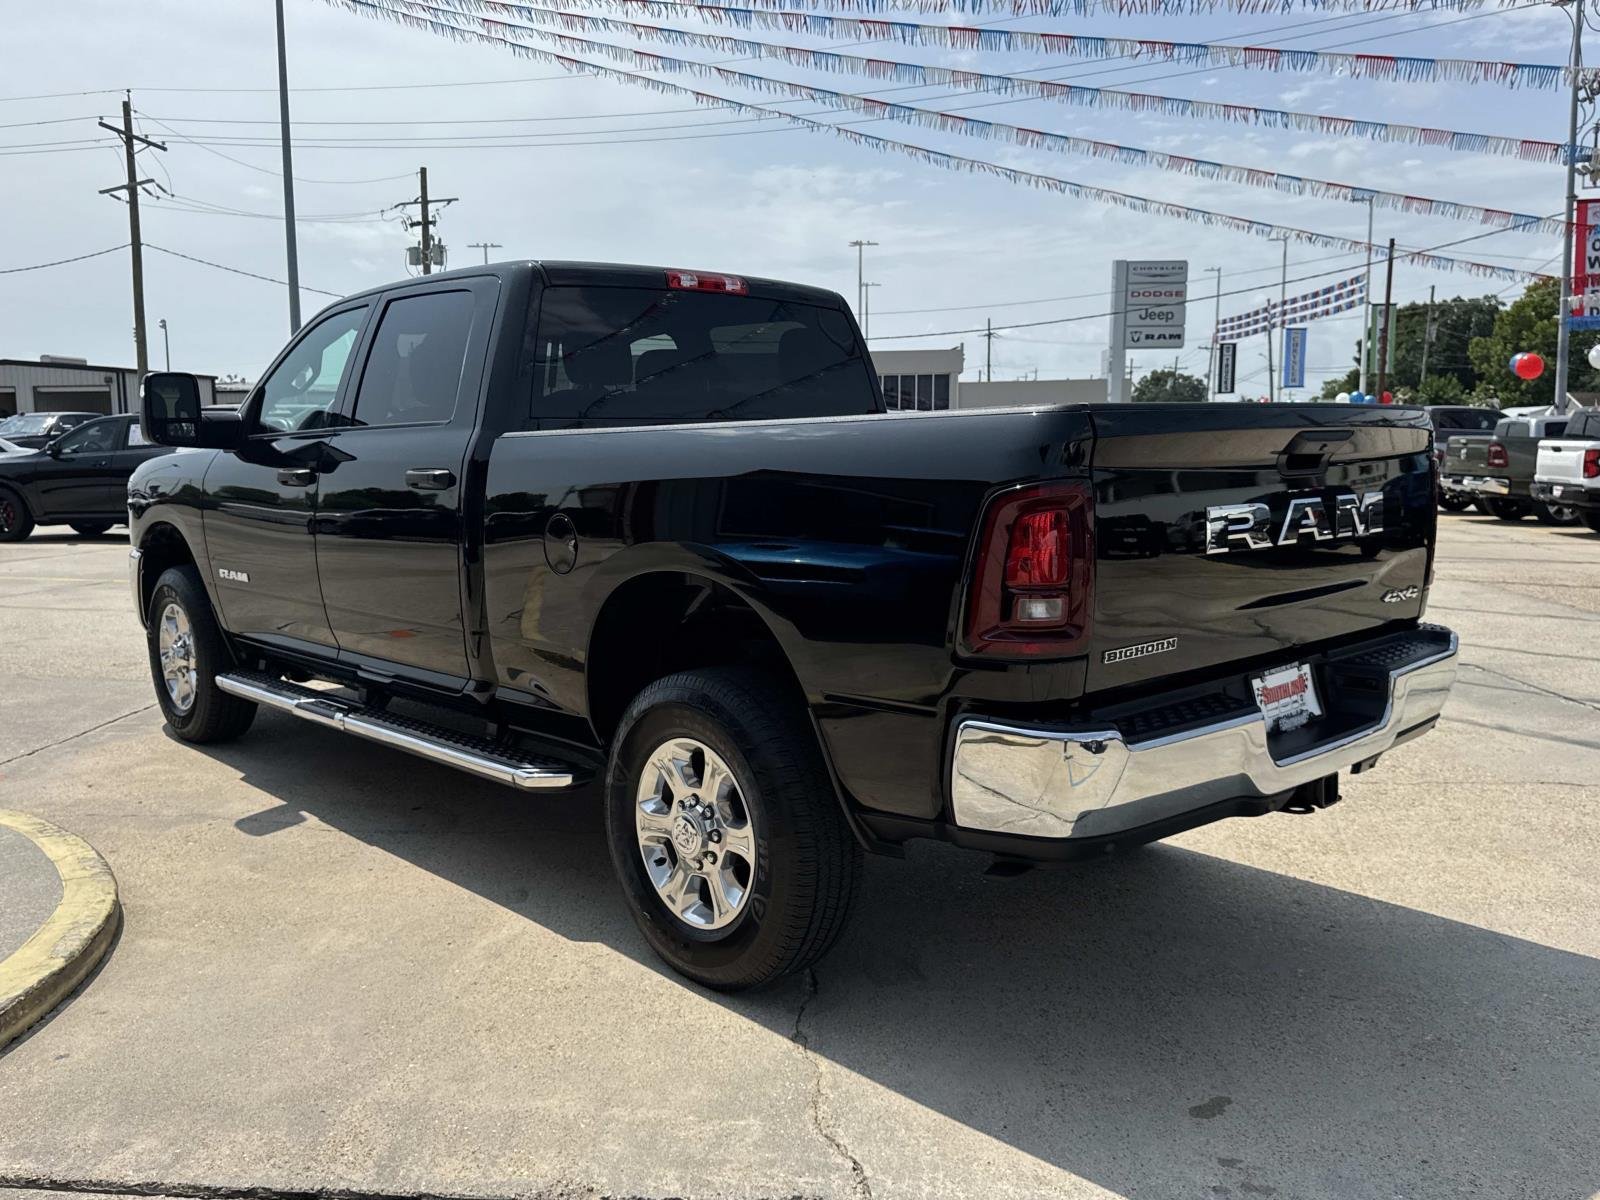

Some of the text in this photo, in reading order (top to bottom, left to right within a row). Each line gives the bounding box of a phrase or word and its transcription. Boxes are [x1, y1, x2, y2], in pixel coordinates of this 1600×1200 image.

[1139, 308, 1175, 323] Jeep
[1206, 491, 1384, 554] RAM
[219, 568, 249, 583] RAM
[1104, 637, 1178, 664] BIGHORN
